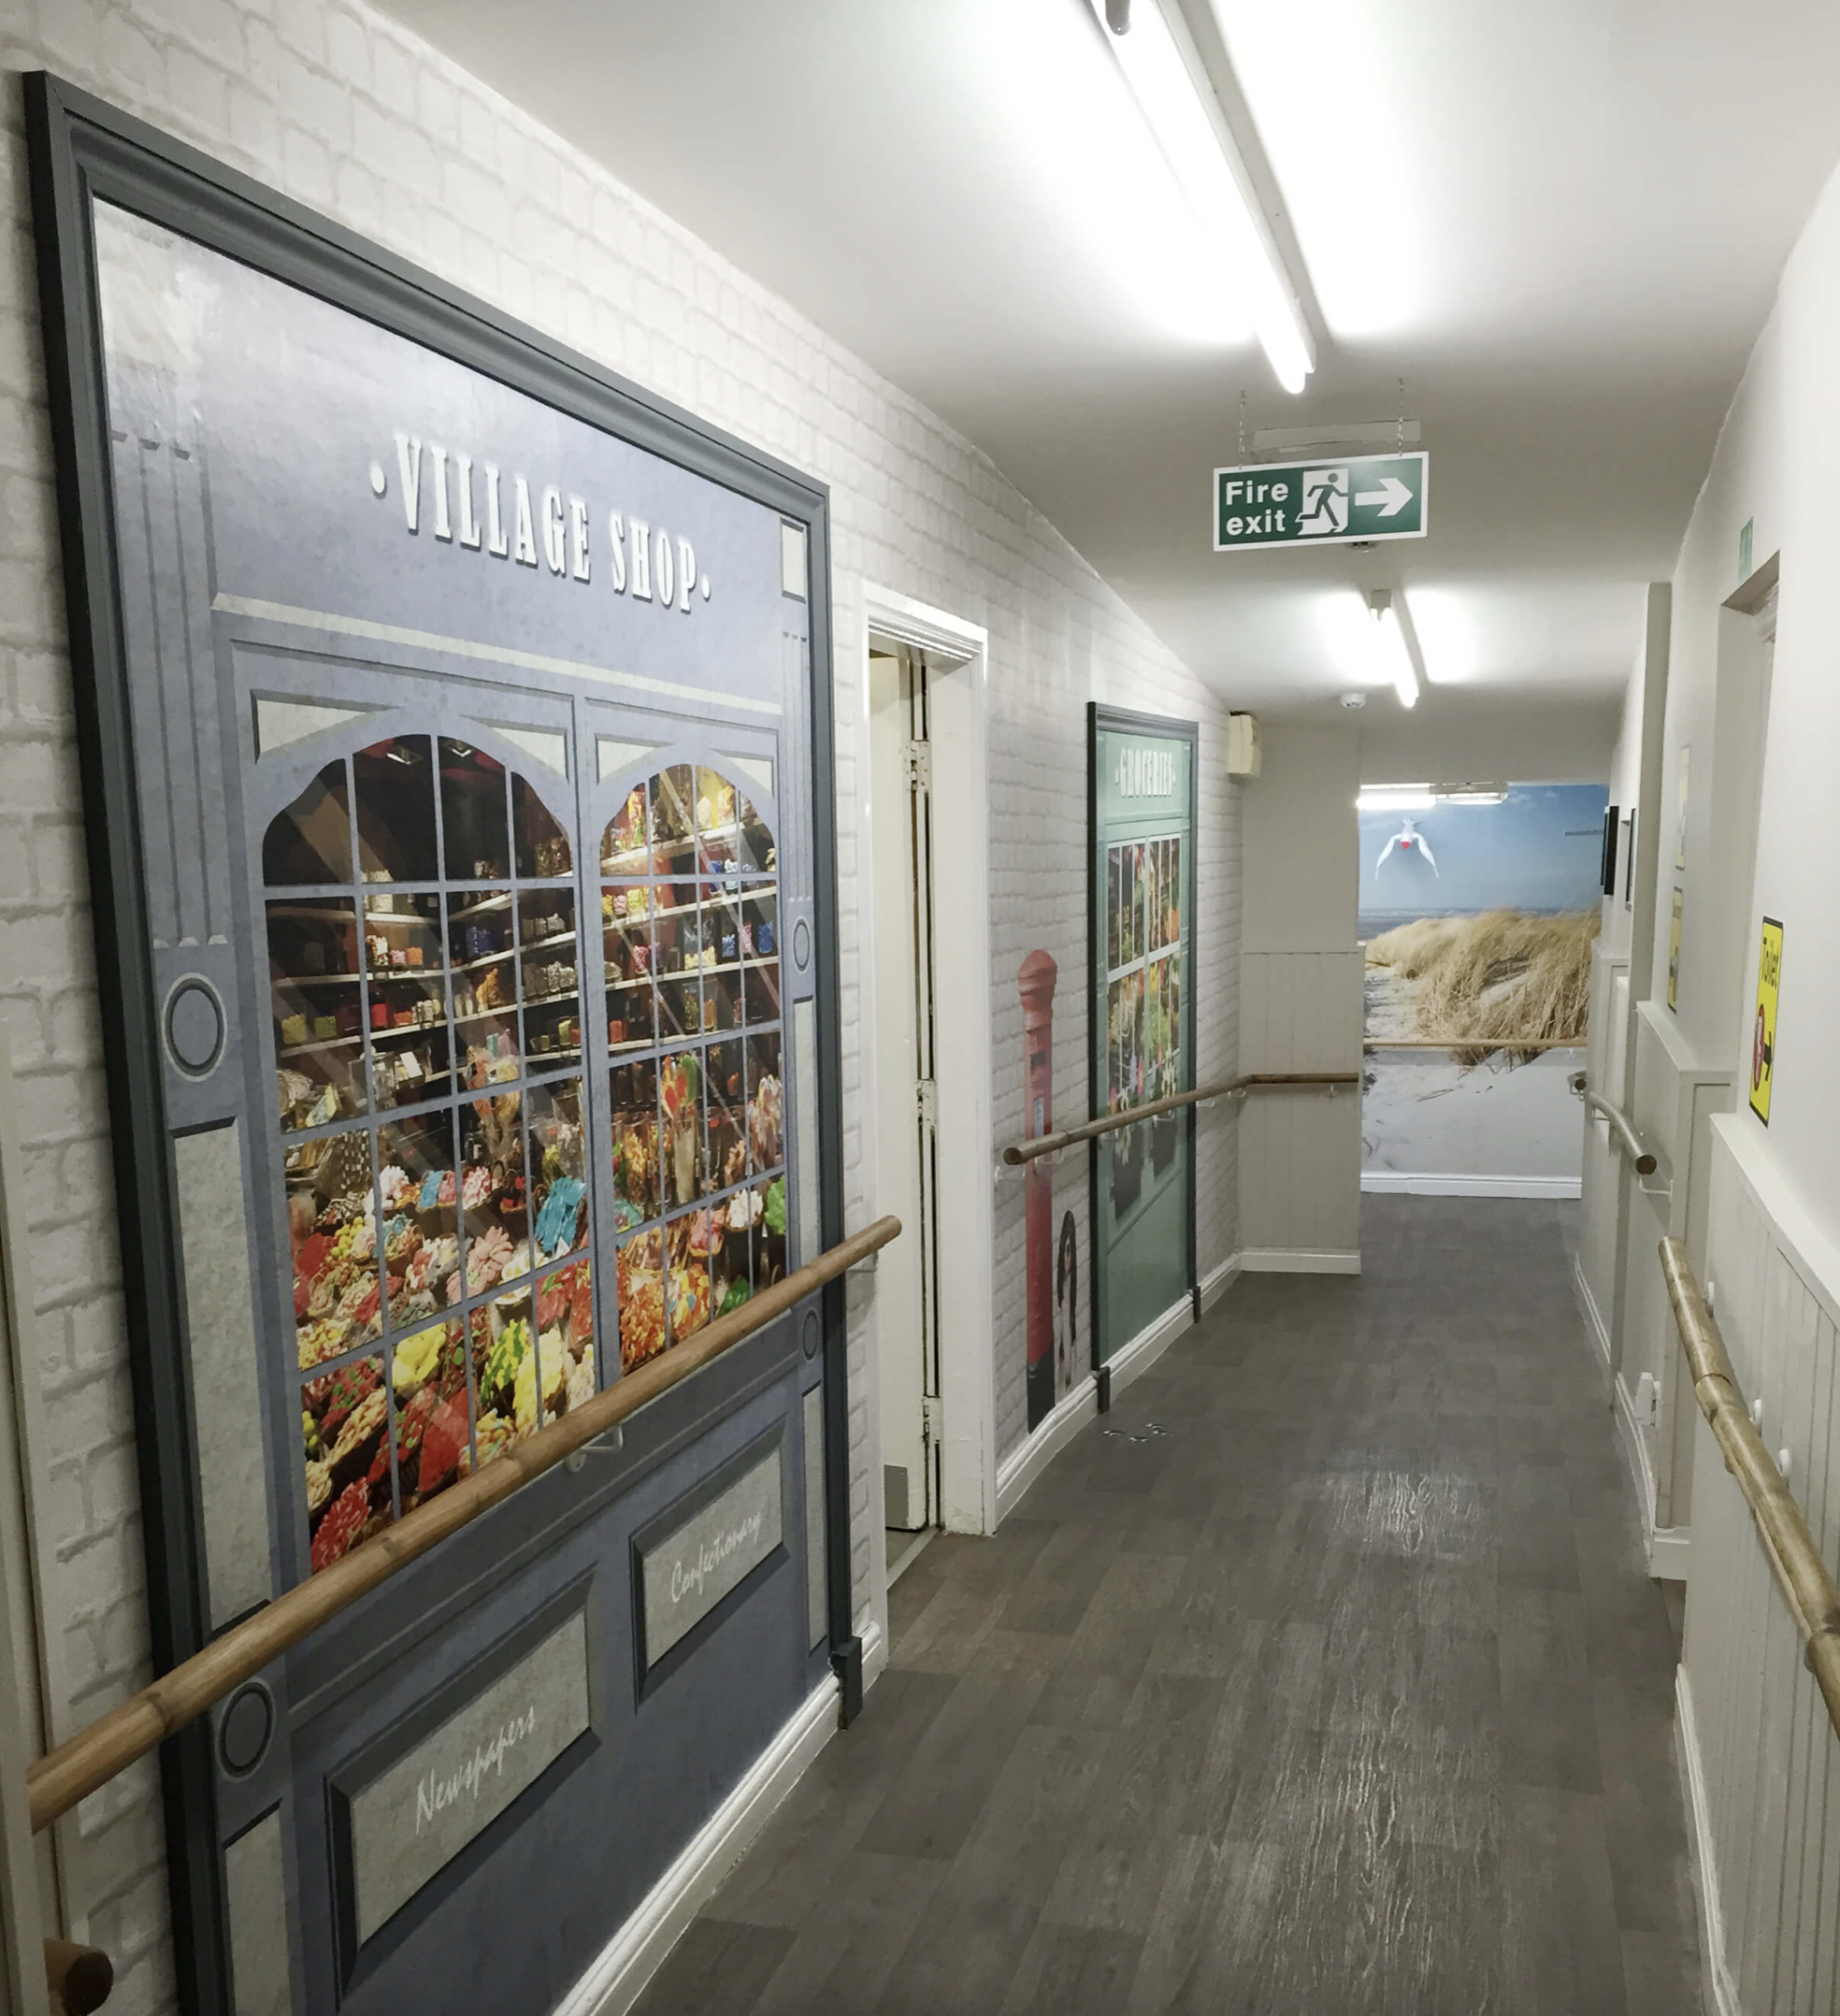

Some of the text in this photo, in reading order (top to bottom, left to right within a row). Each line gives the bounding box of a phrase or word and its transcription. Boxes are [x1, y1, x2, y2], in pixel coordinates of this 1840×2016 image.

[395, 431, 697, 613] VILLAGE SHOP
[1226, 480, 1289, 506] Fire
[1226, 509, 1287, 536] exit
[416, 1706, 535, 1835] Newspapers
